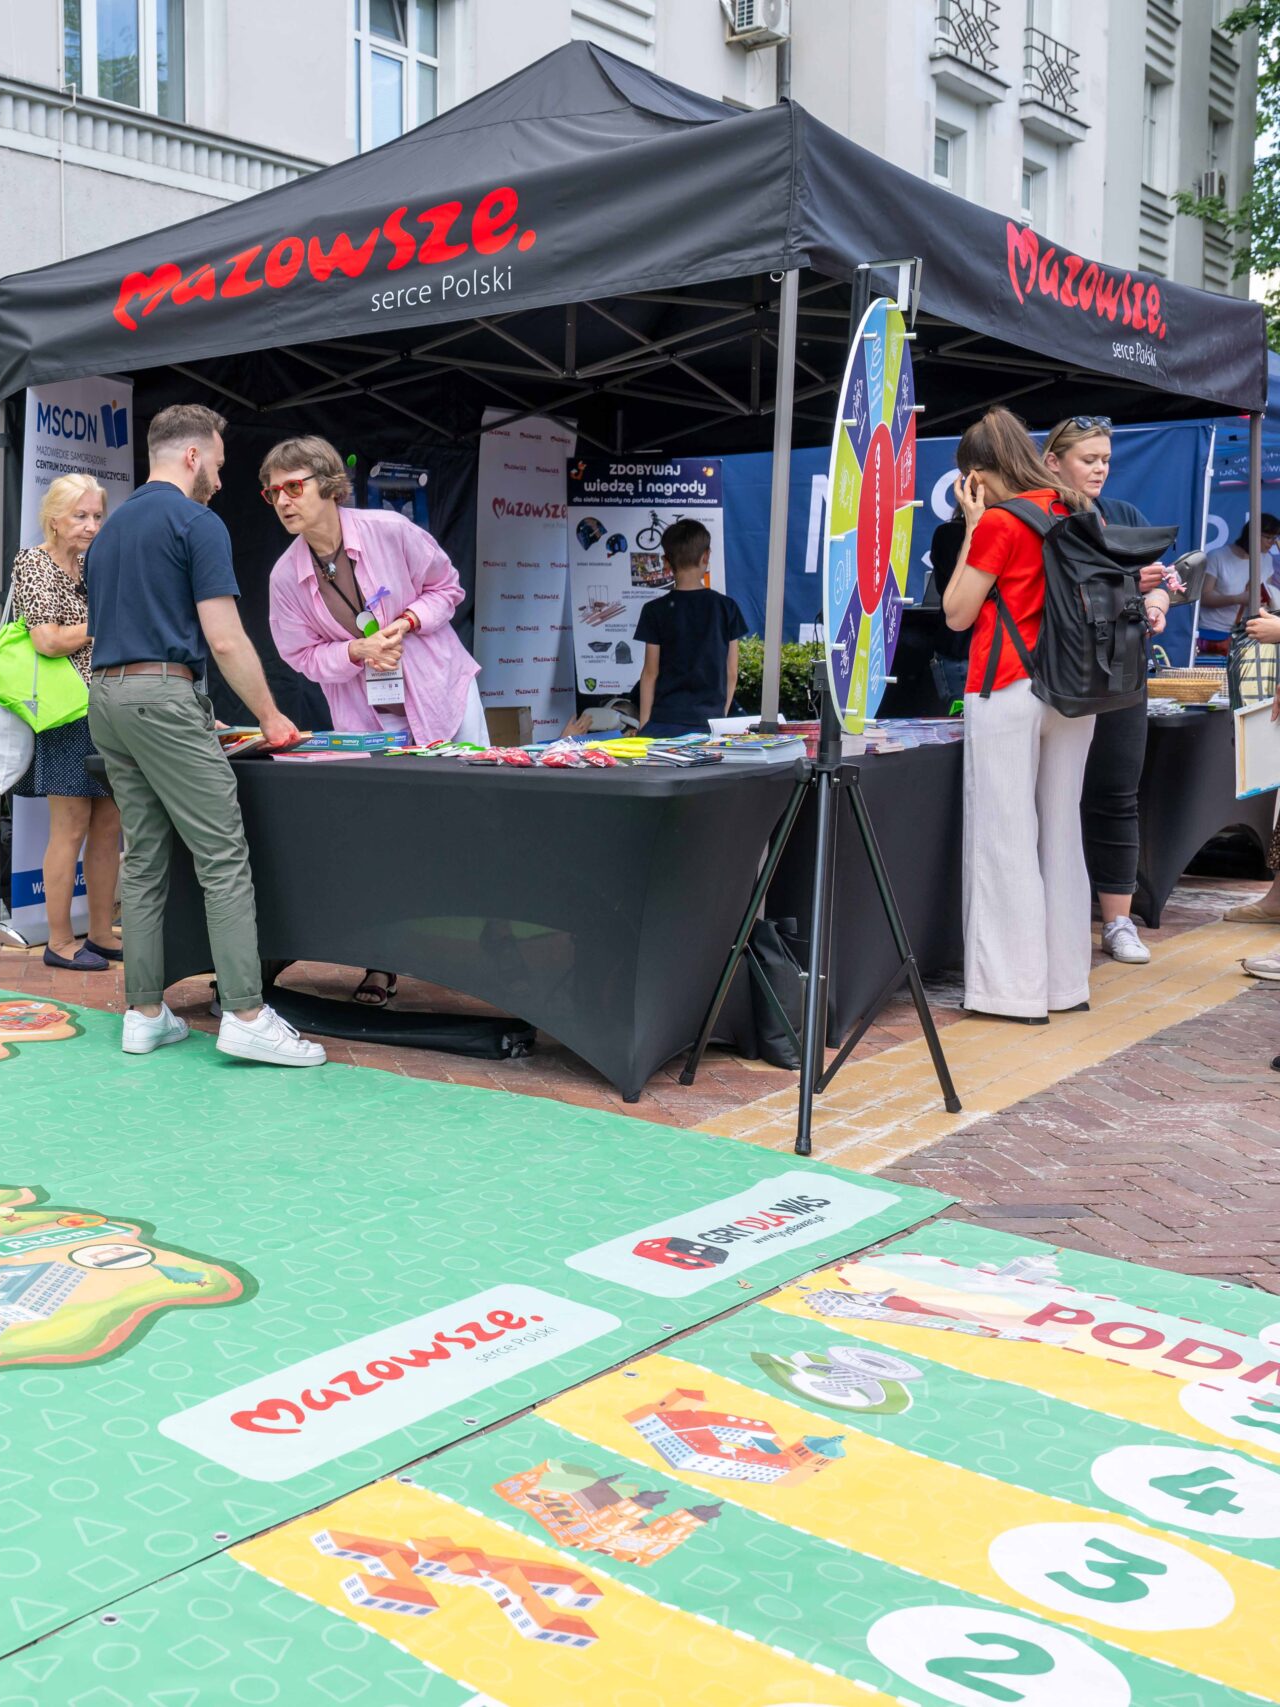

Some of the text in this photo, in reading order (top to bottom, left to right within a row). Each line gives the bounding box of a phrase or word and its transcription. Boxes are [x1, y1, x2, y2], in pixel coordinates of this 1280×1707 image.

[371, 265, 512, 312] serce Polski
[1112, 341, 1157, 367] serce Polski
[36, 402, 98, 443] MSCDN
[35, 459, 59, 472] CENTRUM
[609, 464, 680, 476] ZDOBYWAJ
[584, 479, 707, 496] wiedzę i nagrody
[5, 1229, 95, 1249] Radom
[697, 1195, 831, 1244] GRY DLA WAS
[474, 1322, 559, 1365] serce Polski
[1149, 1466, 1245, 1516] 4
[1045, 1537, 1168, 1604] 3
[925, 1632, 1056, 1702] 2
